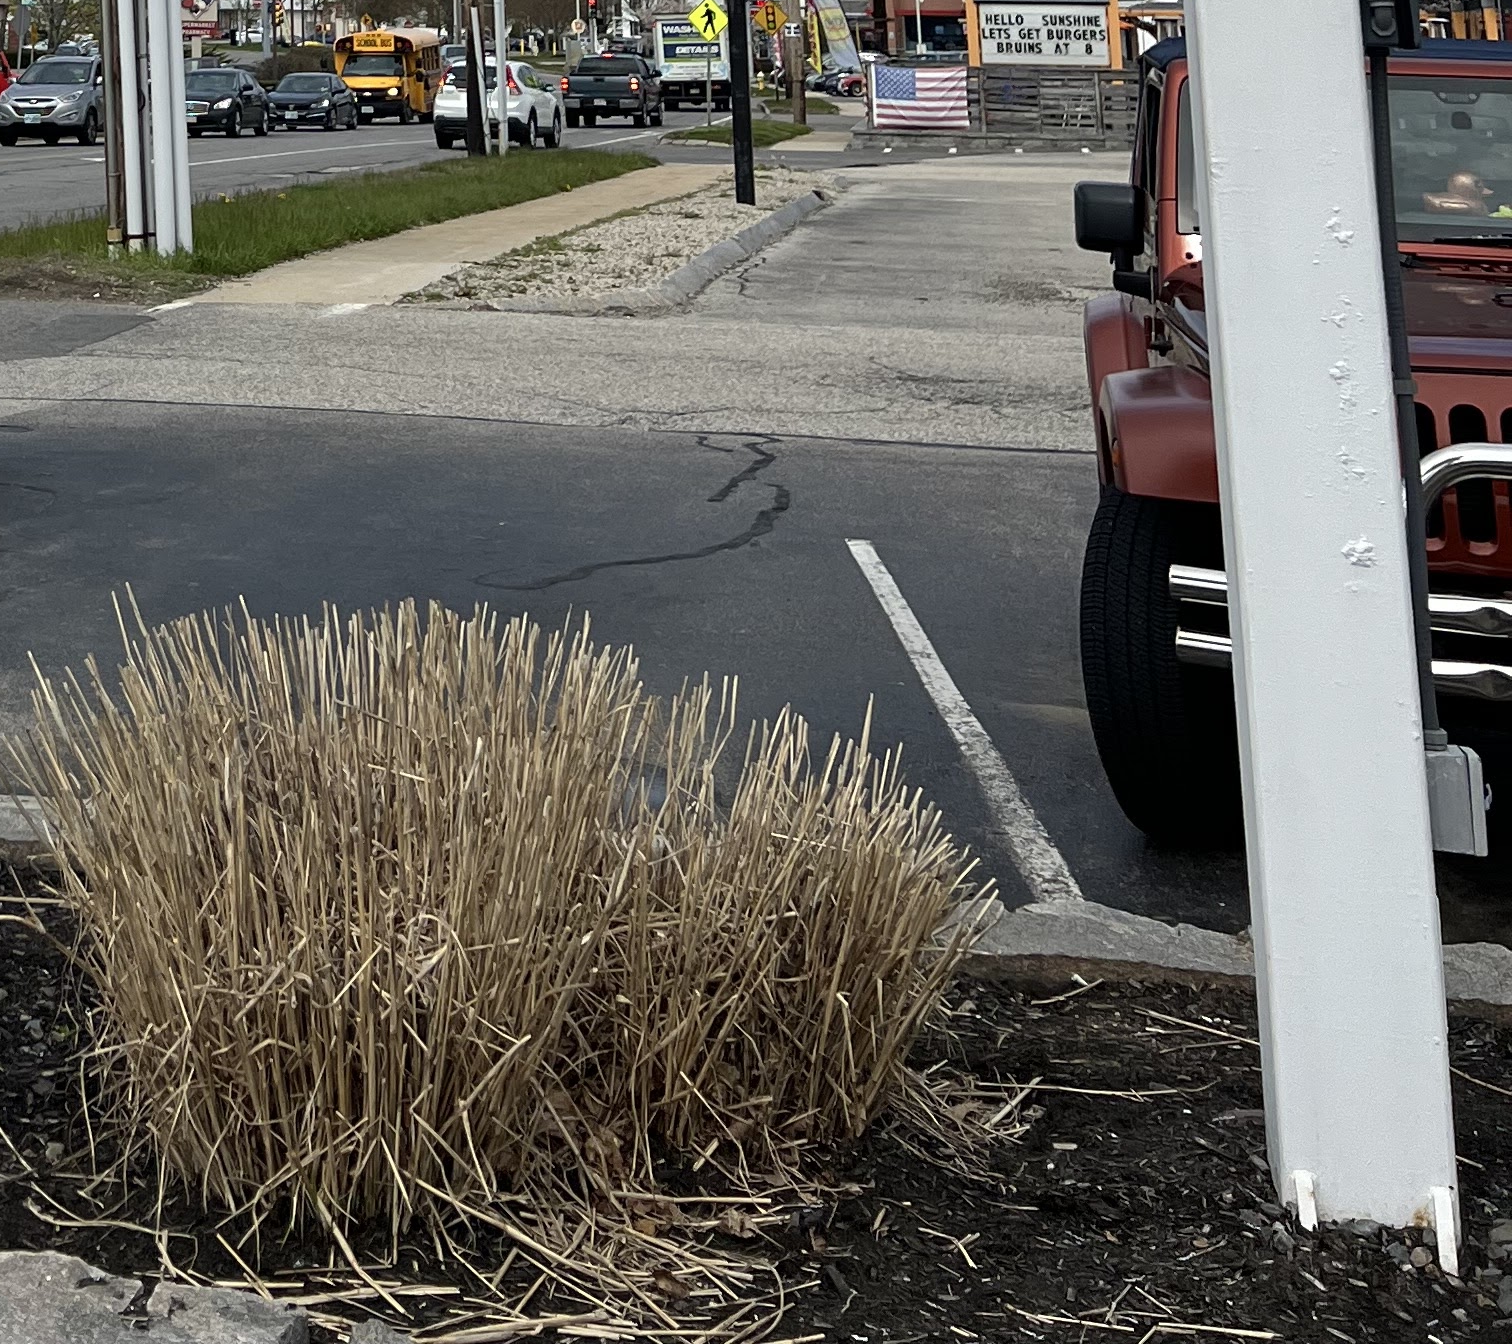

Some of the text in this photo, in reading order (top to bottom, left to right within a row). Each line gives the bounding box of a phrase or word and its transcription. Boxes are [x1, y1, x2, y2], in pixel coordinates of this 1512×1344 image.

[985, 13, 1102, 28] HELLO SUNSHINE
[981, 27, 1106, 41] LETS GET BURGERS
[356, 39, 392, 47] SCHOOL BUS
[996, 42, 1043, 55] BRUINS
[1054, 43, 1071, 56] AT
